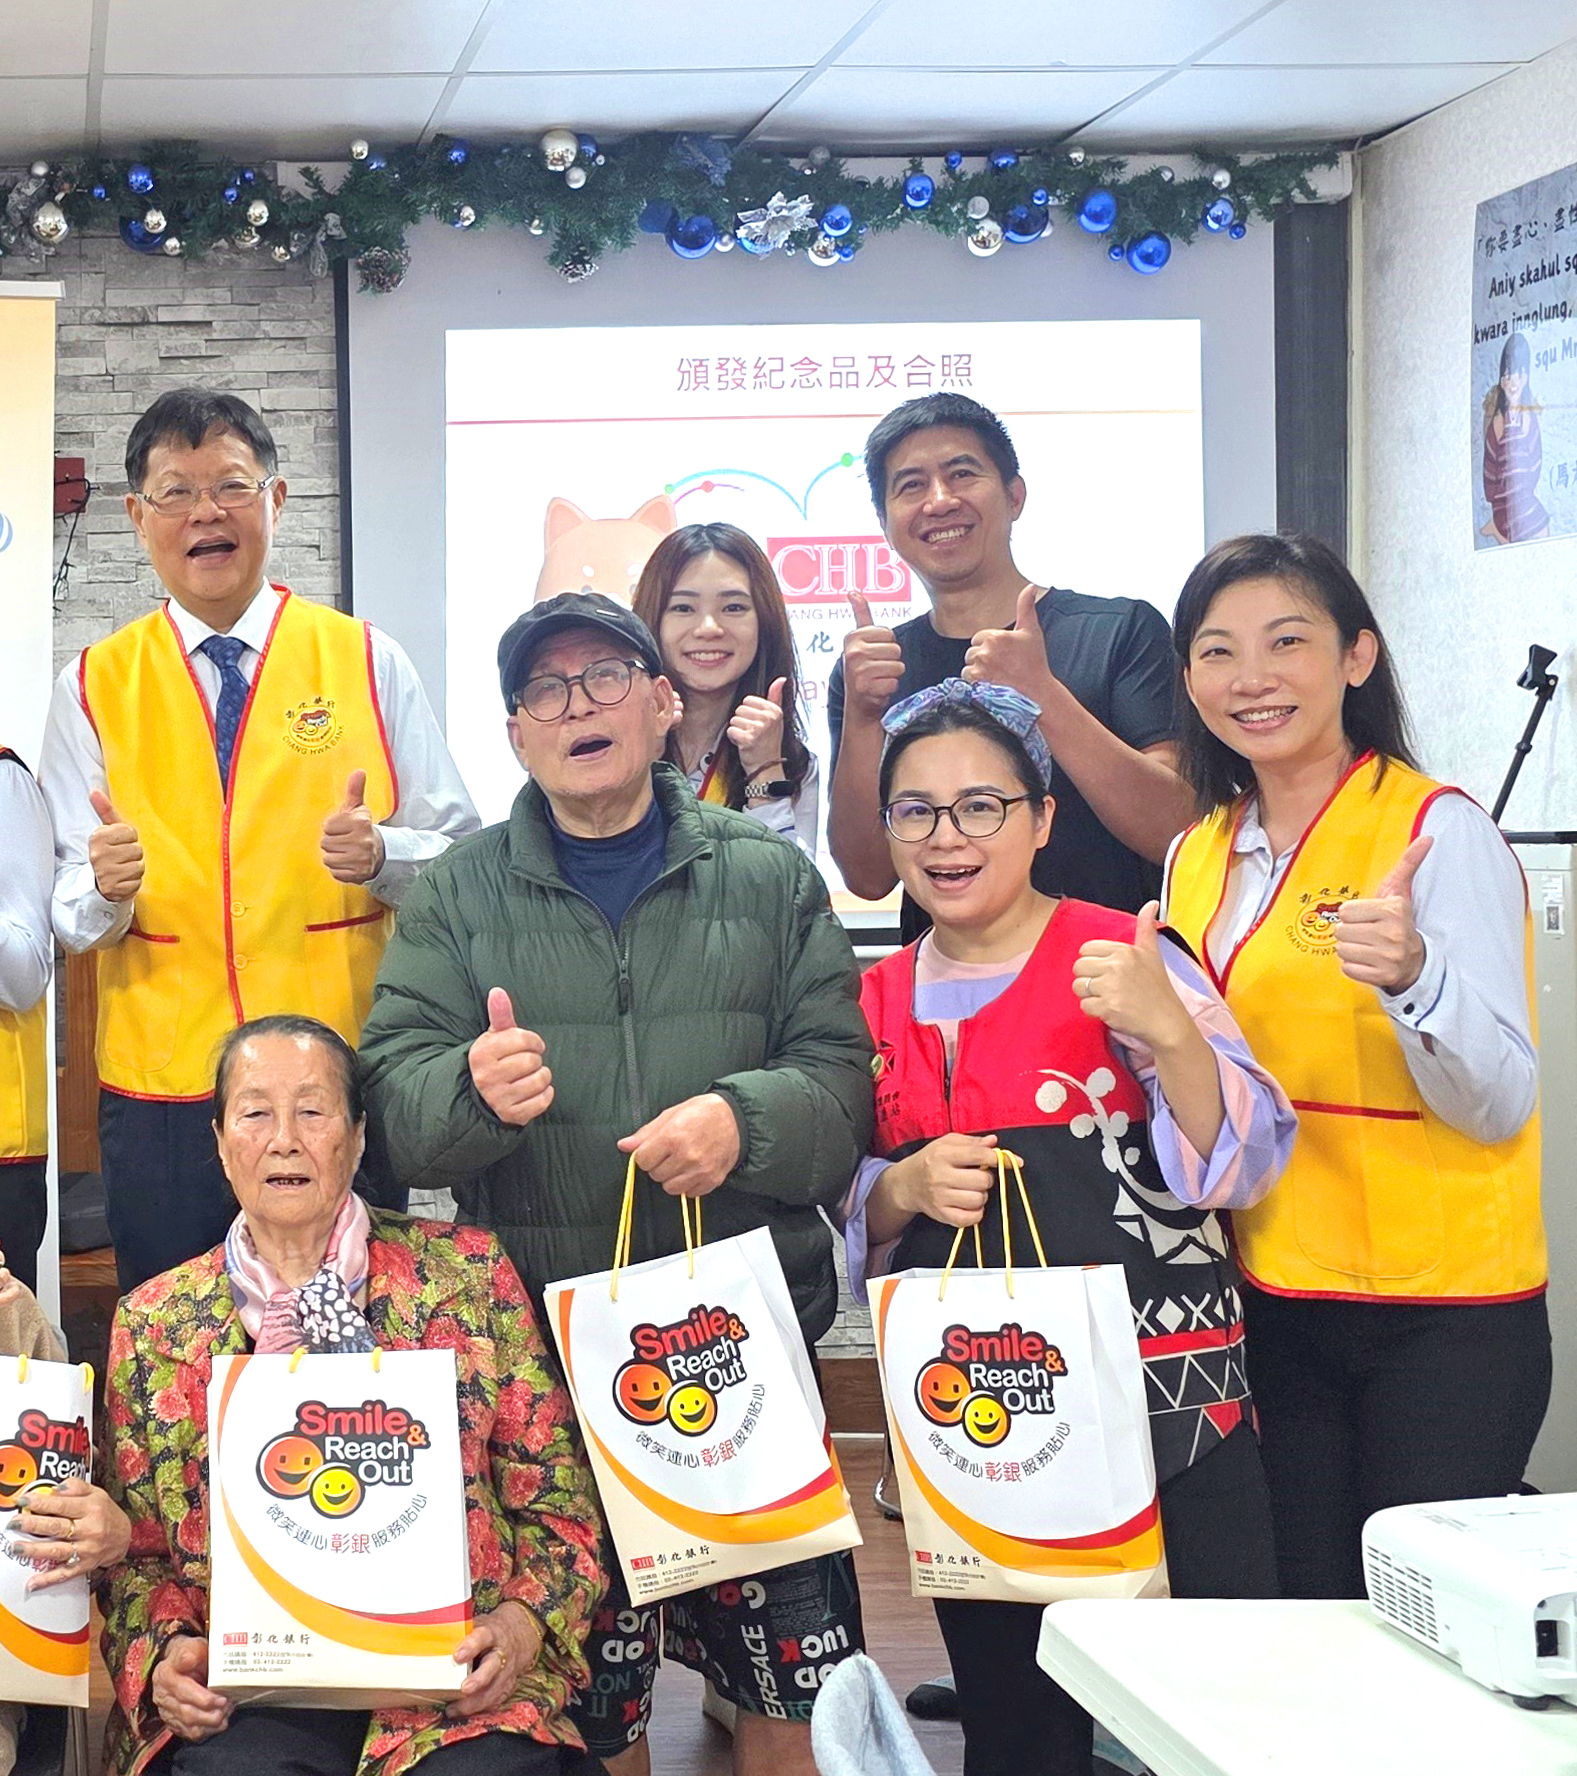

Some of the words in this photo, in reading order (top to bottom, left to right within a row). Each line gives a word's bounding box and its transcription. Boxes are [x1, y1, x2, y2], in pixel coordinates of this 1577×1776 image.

[1489, 273, 1516, 299] Aniy
[1519, 253, 1561, 288] skahul
[1473, 319, 1508, 345] kwara
[676, 351, 975, 393] 頒發紀念品及合照
[1535, 344, 1557, 372] squ
[771, 543, 906, 597] CHB
[828, 608, 855, 620] HW
[635, 1309, 727, 1361] Smile
[945, 1328, 1044, 1363] Smile
[666, 1338, 739, 1385] Reach
[704, 1357, 747, 1393] Out
[969, 1362, 1051, 1390] Reach
[1001, 1388, 1054, 1412] Out
[299, 1403, 408, 1436] Smile
[325, 1435, 409, 1461] Reach
[358, 1459, 413, 1484] Out
